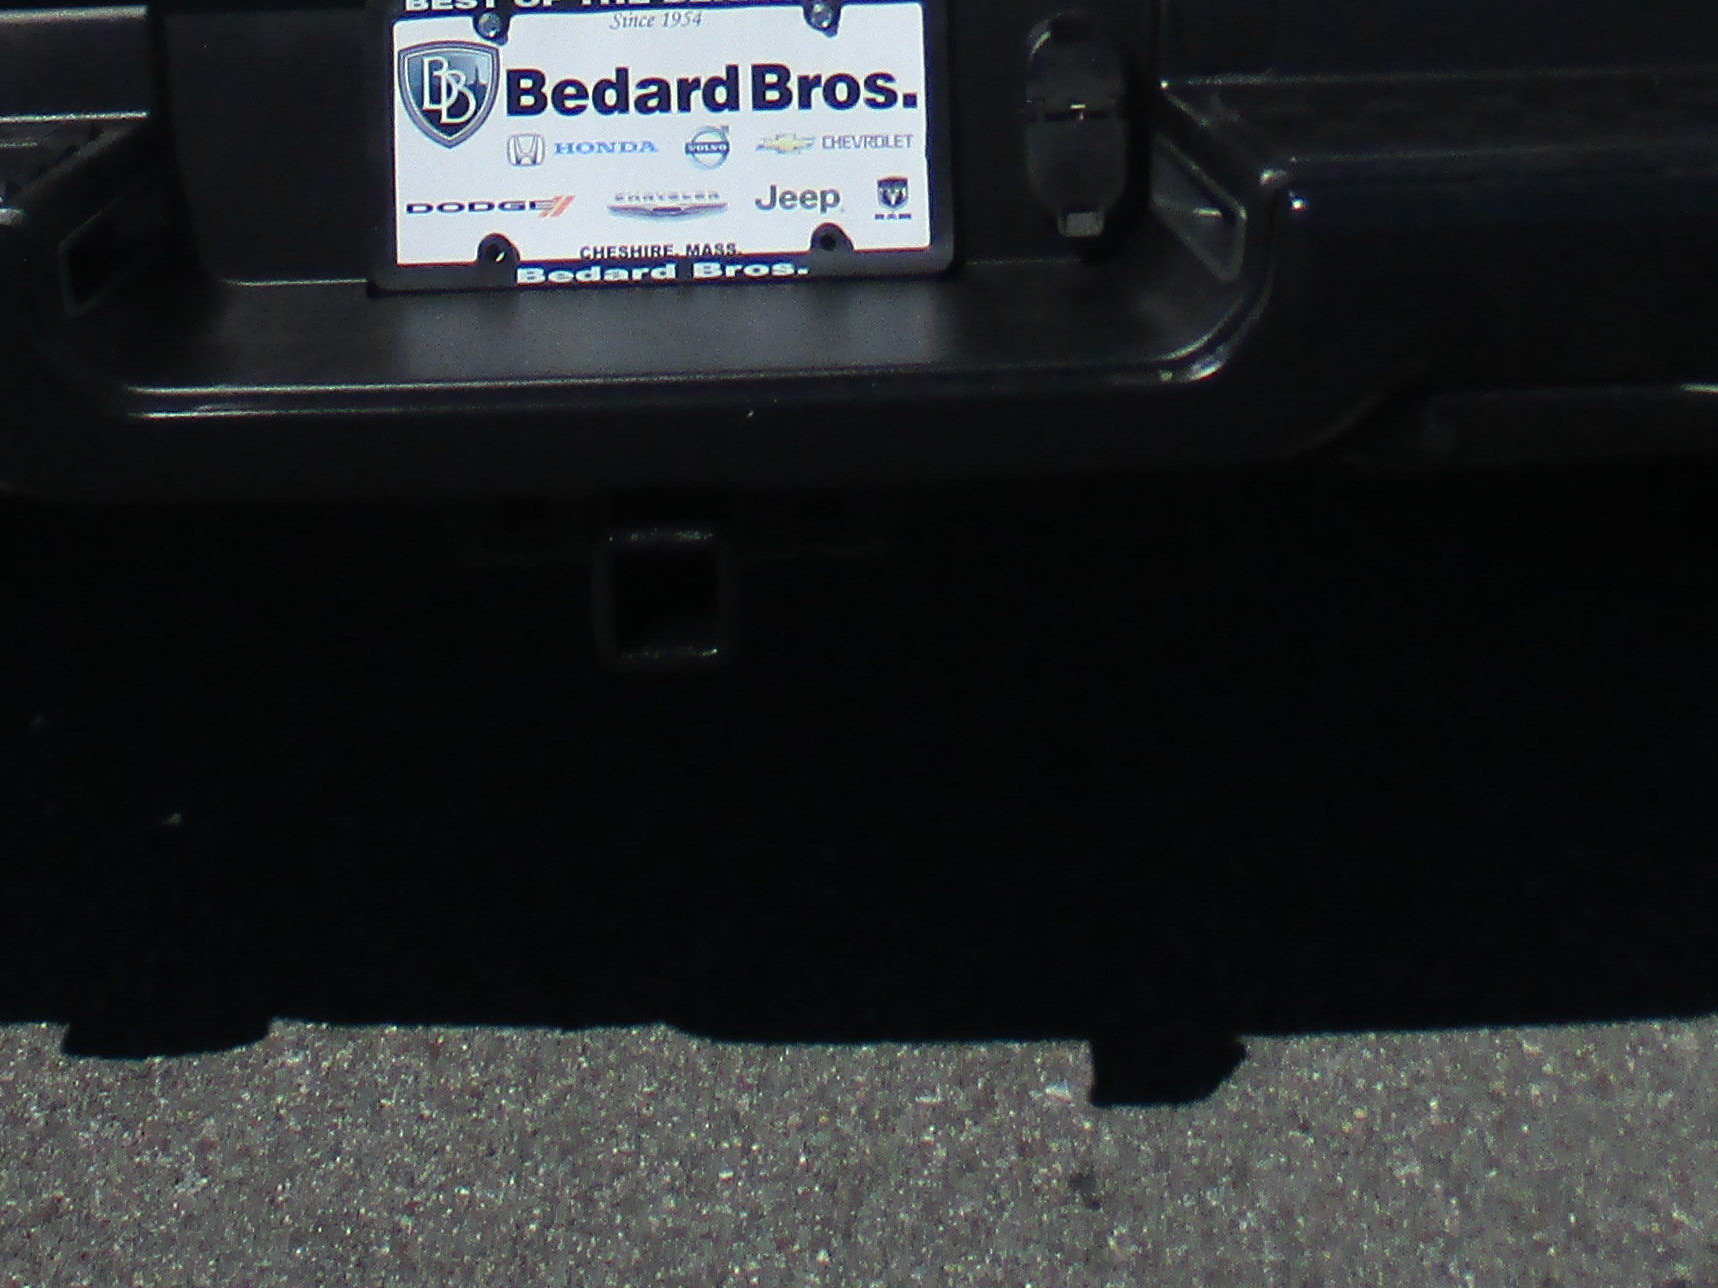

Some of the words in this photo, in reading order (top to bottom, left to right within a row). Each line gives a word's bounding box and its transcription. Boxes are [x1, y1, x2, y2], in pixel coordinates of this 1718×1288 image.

[609, 11, 656, 30] Since
[661, 10, 703, 28] 1954
[554, 140, 658, 155] HONDA
[687, 143, 728, 154] VOLVO
[821, 134, 914, 150] CHEVROLET
[406, 199, 555, 214] DODGE
[755, 184, 841, 214] Jeep
[516, 262, 677, 284] Bedard
[693, 261, 810, 280] Bros.
